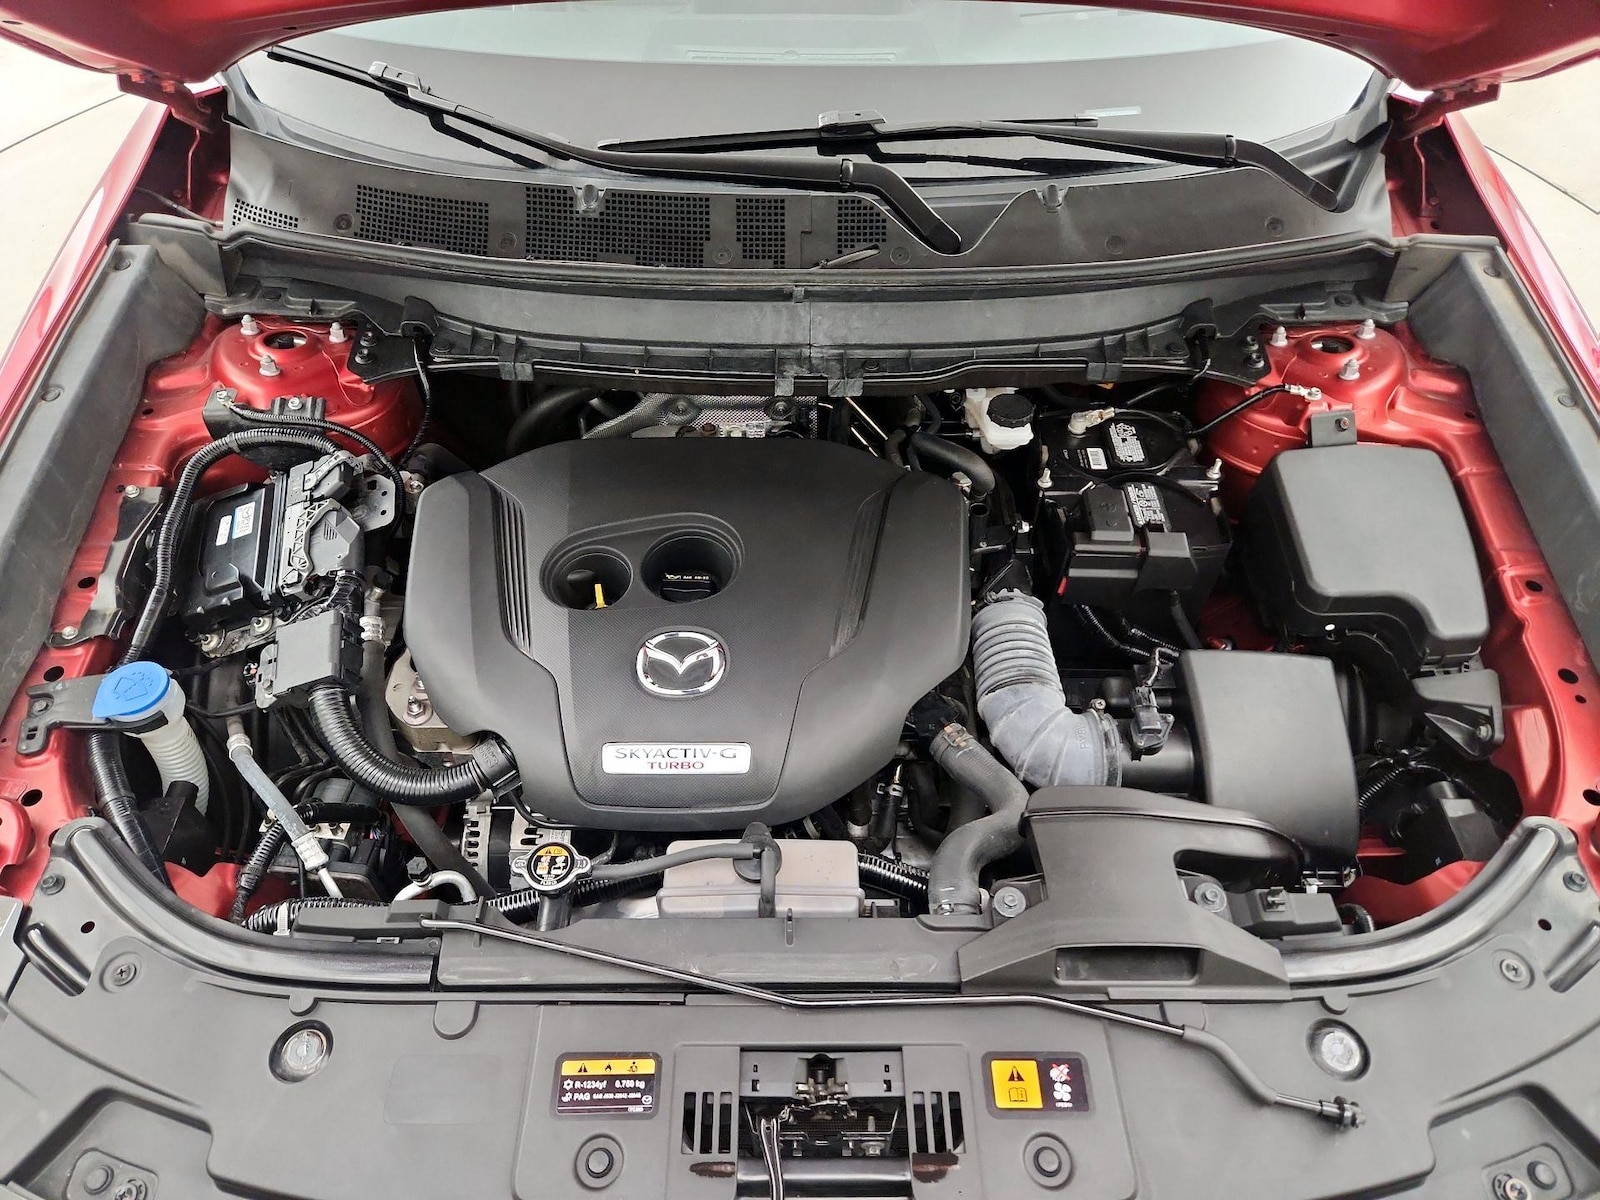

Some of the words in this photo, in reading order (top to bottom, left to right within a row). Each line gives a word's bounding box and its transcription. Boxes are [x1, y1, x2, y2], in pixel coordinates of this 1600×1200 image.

[614, 747, 737, 759] SKYACTIV-G
[647, 761, 704, 770] TURBO
[574, 1080, 607, 1090] R-1234yf
[635, 1079, 645, 1089] kg
[573, 1092, 591, 1101] PAG
